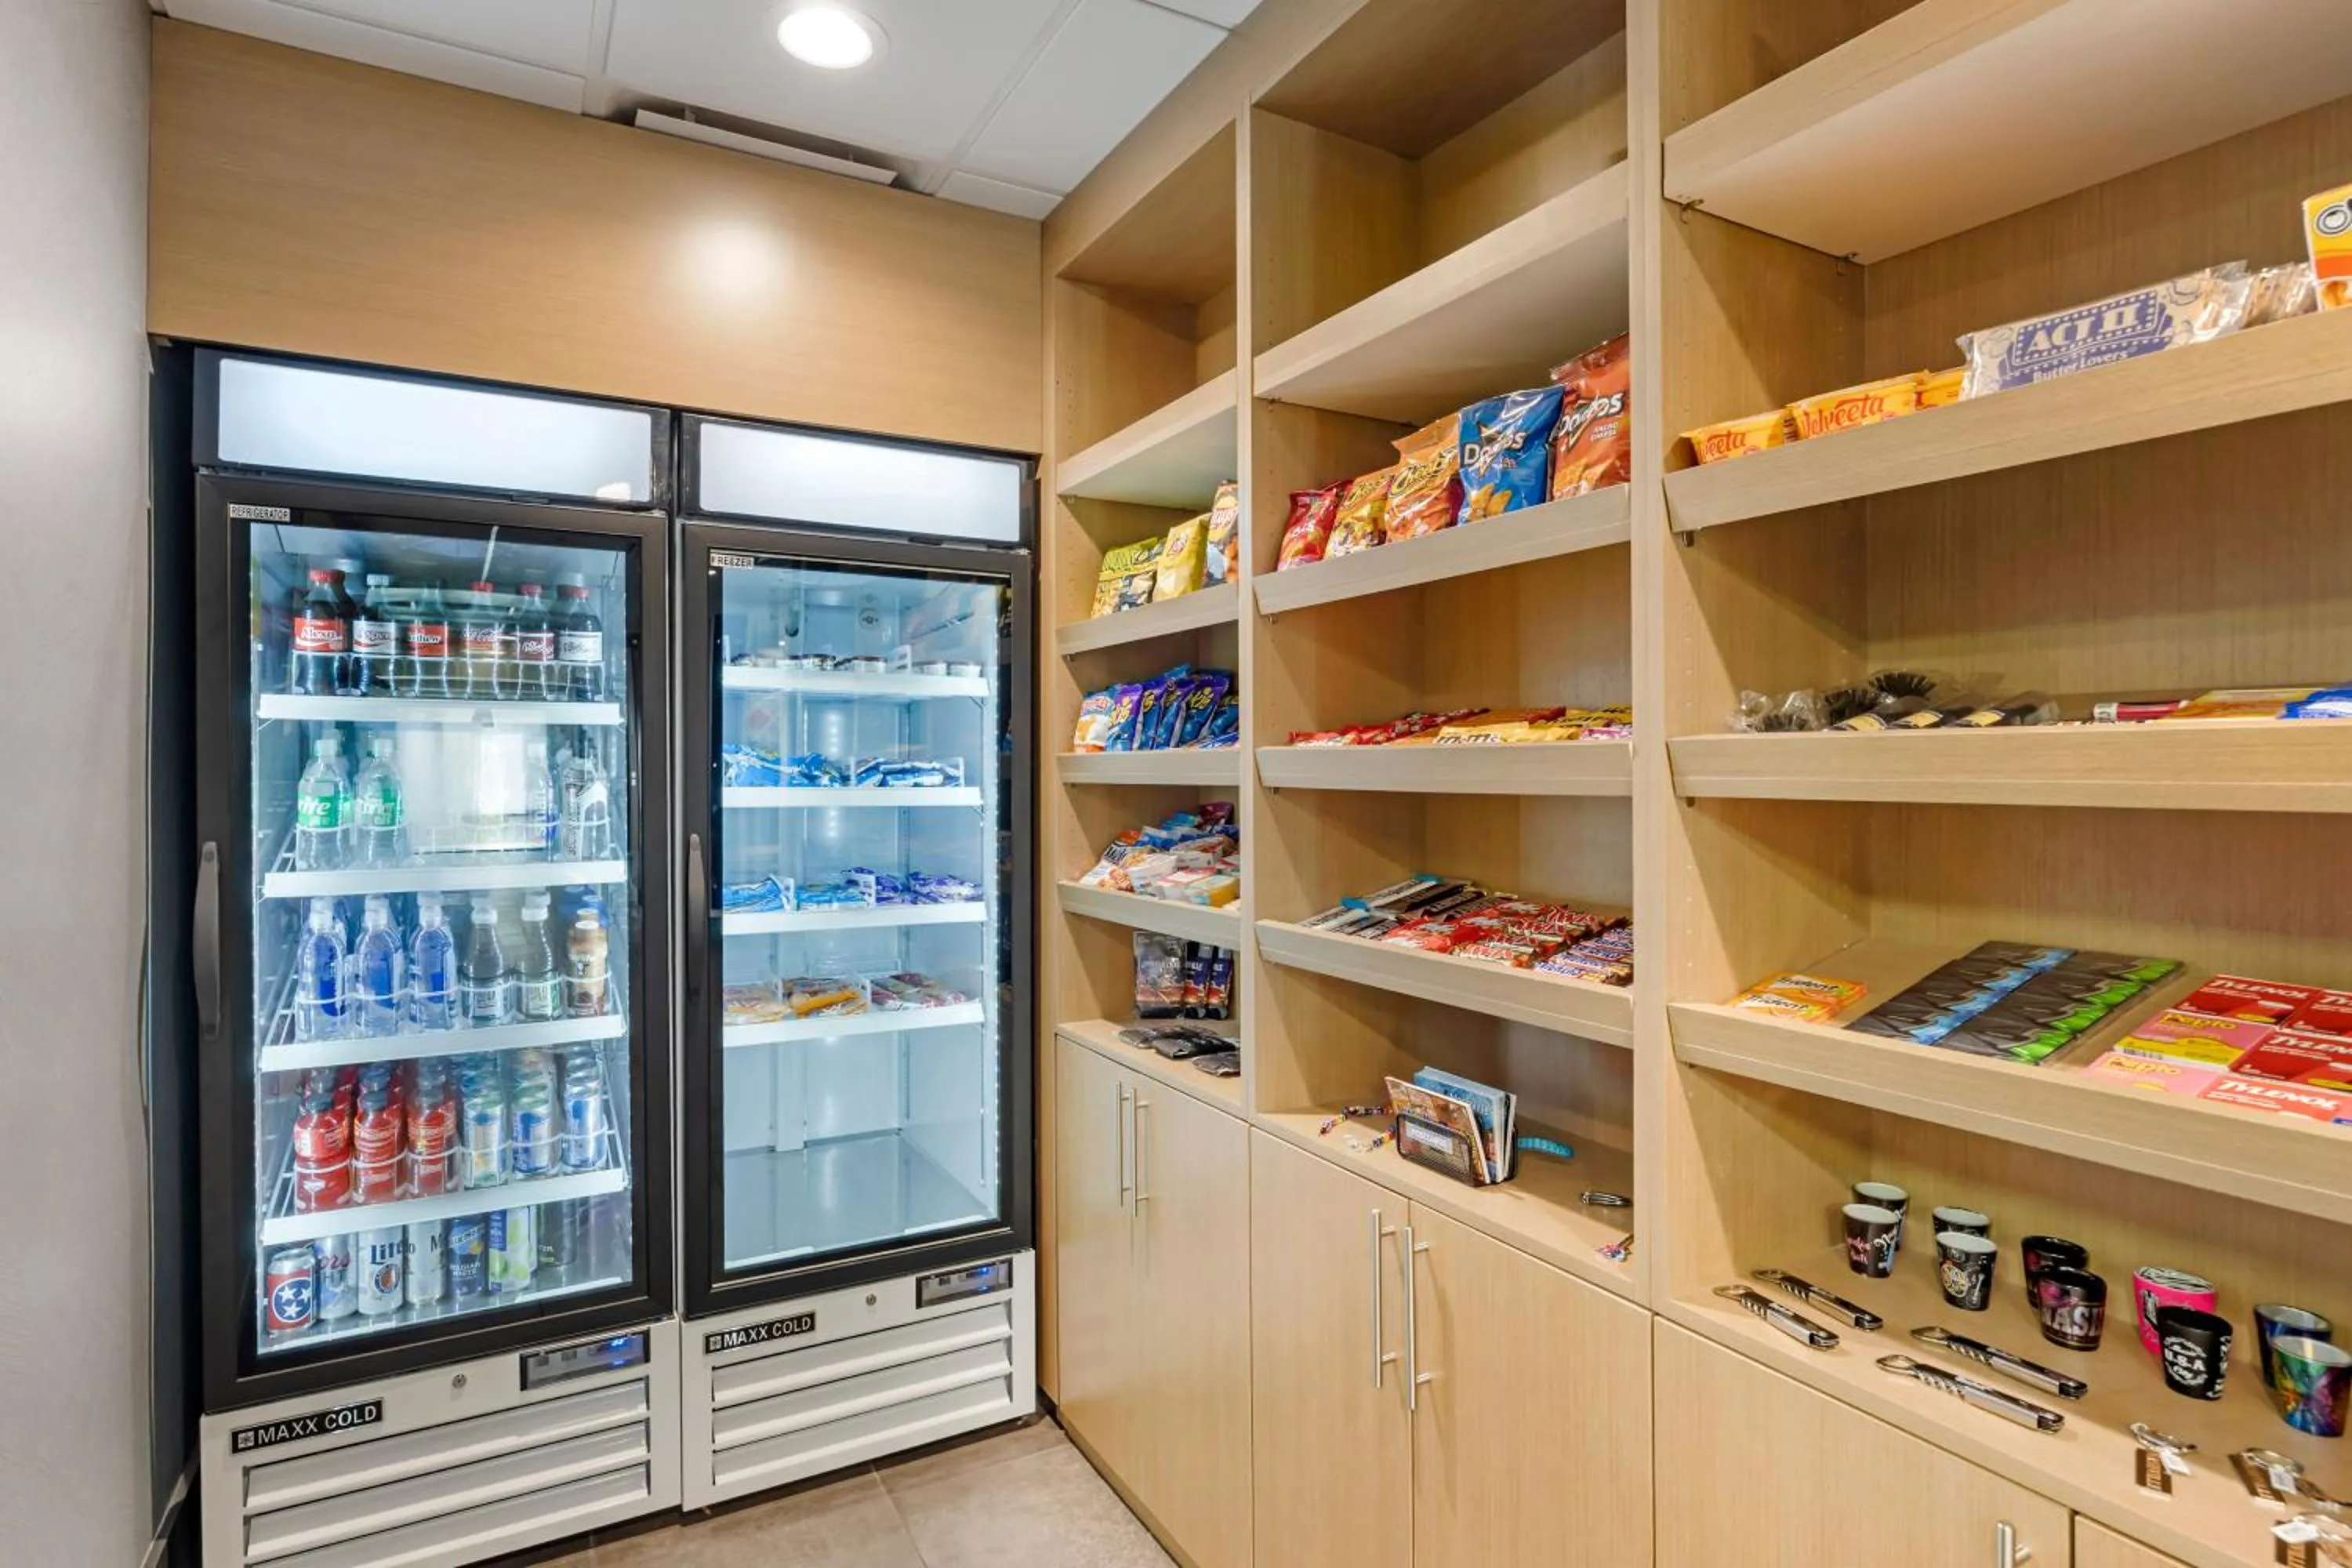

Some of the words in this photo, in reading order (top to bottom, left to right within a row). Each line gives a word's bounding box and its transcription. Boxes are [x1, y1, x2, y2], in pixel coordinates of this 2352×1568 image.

[2027, 316, 2096, 353] ACT
[2099, 303, 2142, 333] II
[1803, 394, 1885, 437] Velveeta
[2209, 978, 2309, 1000] TYLENOL
[2158, 1012, 2237, 1029] Pepto
[2106, 1056, 2182, 1075] Pepto
[2218, 1080, 2341, 1111] TYLENOL
[724, 1325, 768, 1348] MAXX
[772, 1316, 811, 1337] COLD
[257, 1417, 319, 1446] MAXX
[325, 1405, 377, 1429] COLD
